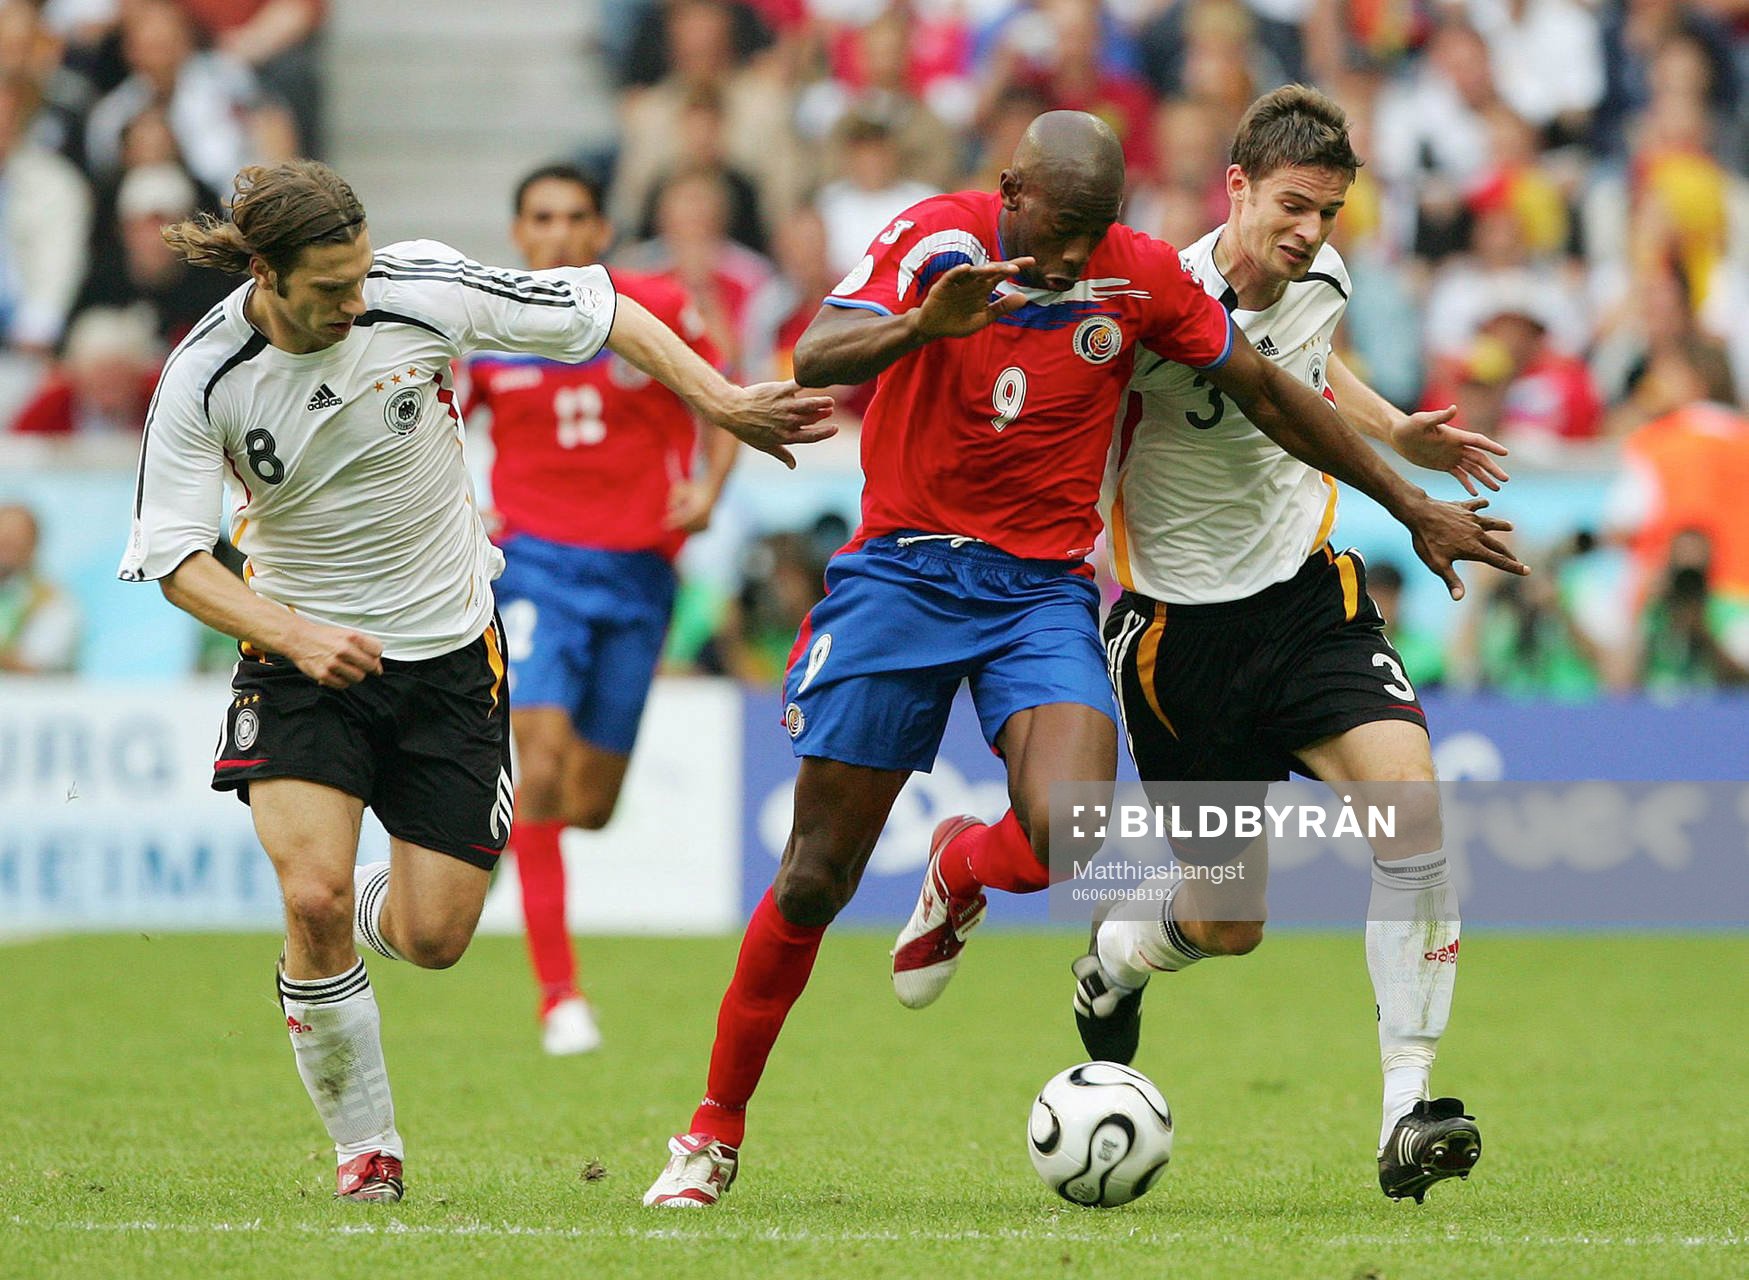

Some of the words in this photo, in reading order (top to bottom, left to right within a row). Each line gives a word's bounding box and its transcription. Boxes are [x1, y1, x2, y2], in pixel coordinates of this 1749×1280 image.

[307, 396, 343, 411] adidas
[992, 366, 1028, 433] 9
[1185, 373, 1225, 430] 3
[245, 428, 285, 485] 8
[797, 633, 832, 694] 9
[1372, 653, 1416, 702] 3
